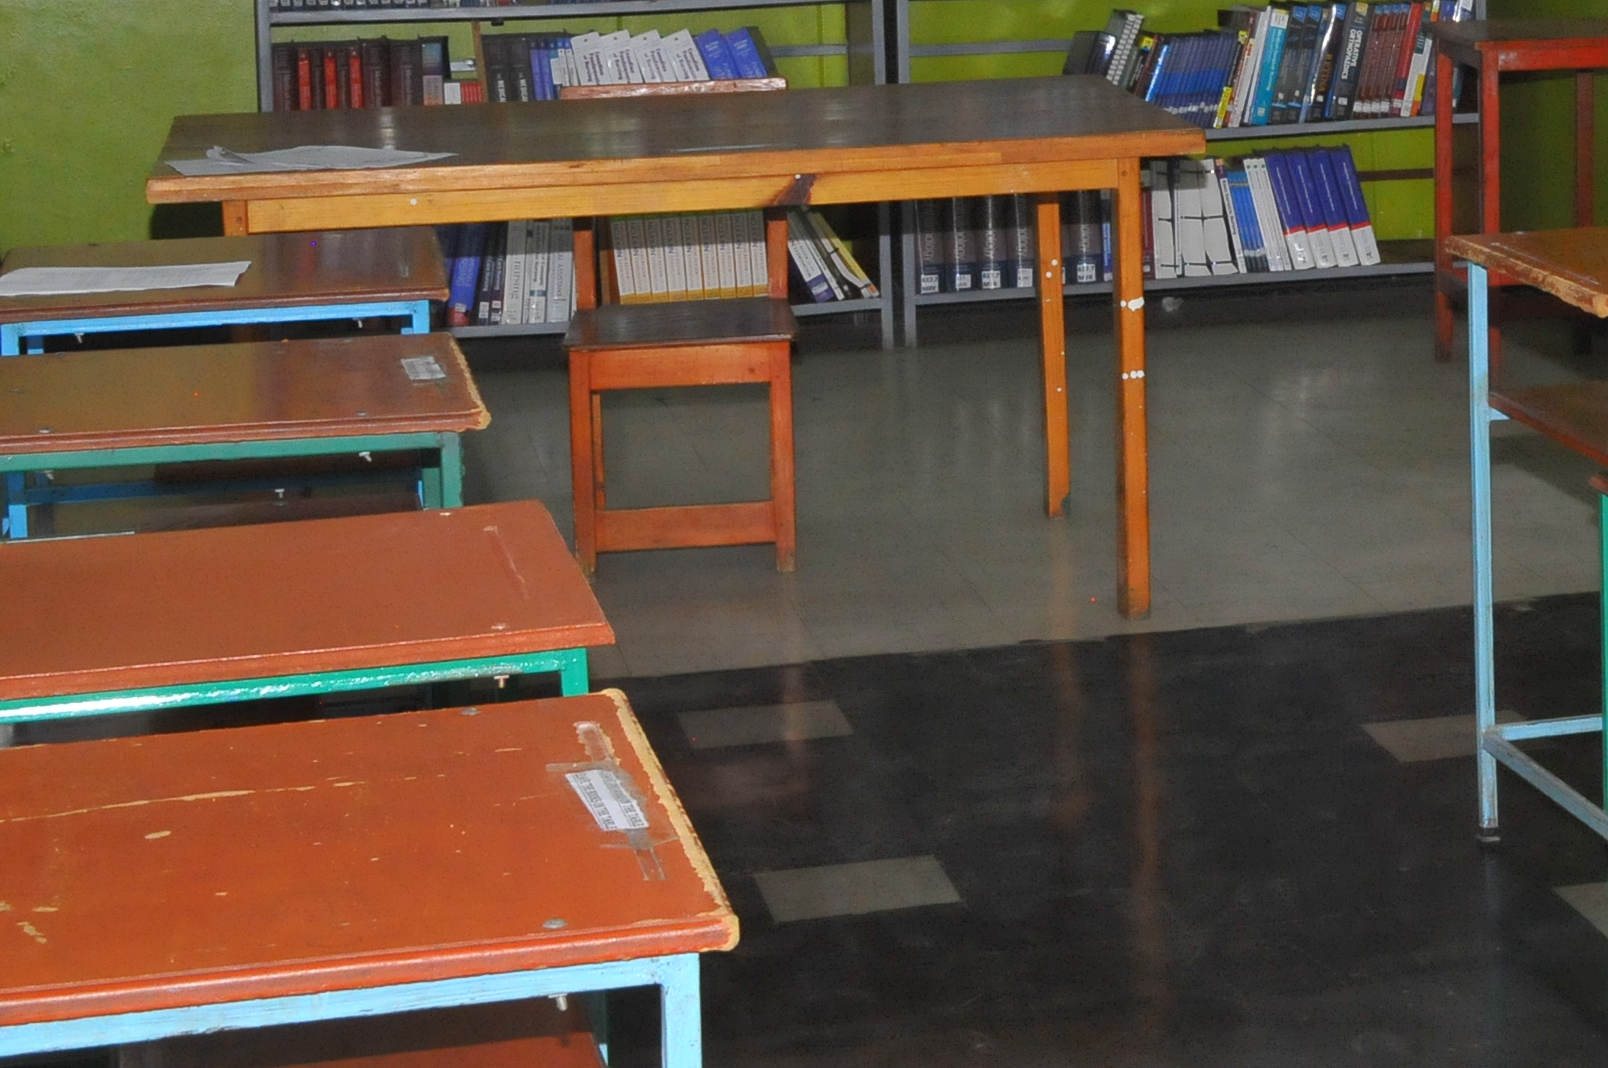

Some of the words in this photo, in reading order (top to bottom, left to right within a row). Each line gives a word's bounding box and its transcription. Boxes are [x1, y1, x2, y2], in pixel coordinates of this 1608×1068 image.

[655, 47, 668, 72] Canadian
[688, 47, 701, 72] Canadian
[1341, 28, 1356, 80] ORTHOPAEDICS
[1350, 30, 1363, 67] OPERATIVE
[584, 60, 594, 82] Nursing
[595, 51, 605, 76] Canadian
[614, 58, 624, 80] Nursing
[625, 49, 635, 74] Canadian
[645, 57, 657, 80] Nursing
[679, 58, 690, 79] Nursing
[482, 272, 490, 292] Nursing
[494, 270, 502, 291] Nursing
[511, 260, 522, 300] nursing
